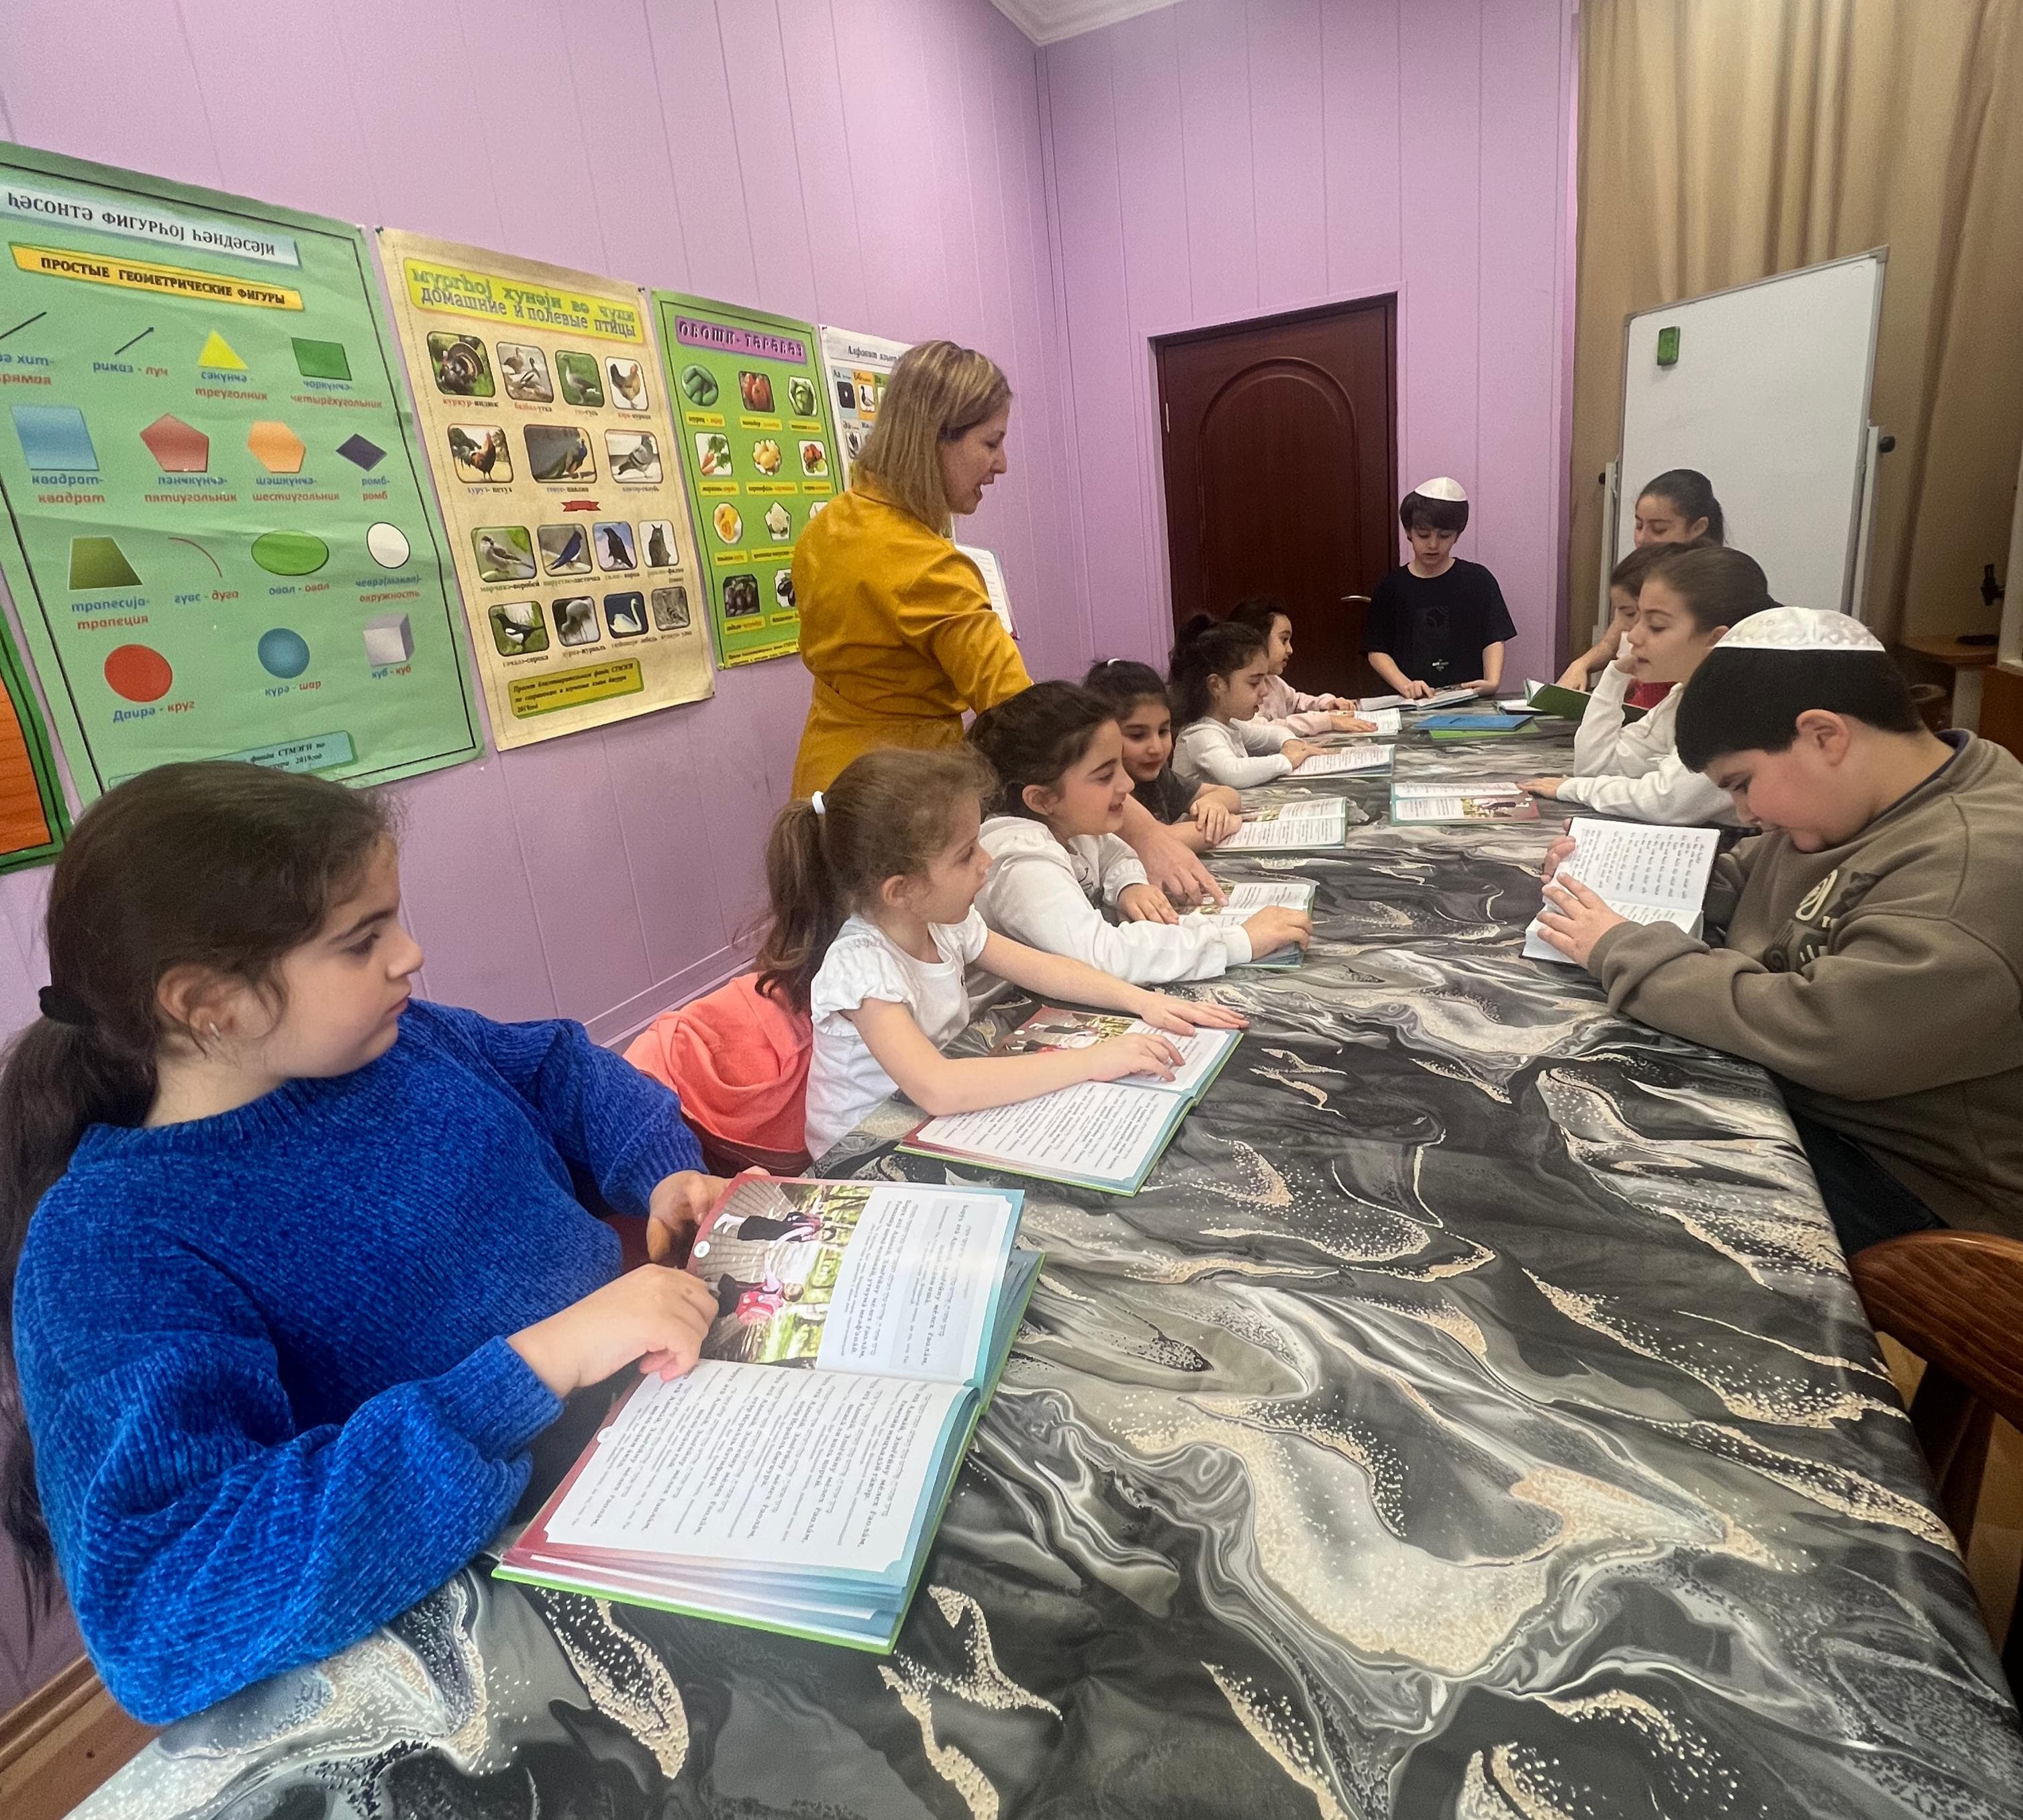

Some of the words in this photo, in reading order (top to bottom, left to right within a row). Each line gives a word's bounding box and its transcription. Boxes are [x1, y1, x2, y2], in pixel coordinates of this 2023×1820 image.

[41, 257, 110, 278] ПРОСТЫЕ
[119, 269, 232, 297] ГЕОМЕТРИЧЕСКИЕ
[238, 289, 285, 305] ФИГУРЫ
[513, 303, 524, 319] и
[526, 306, 588, 330] полевые
[594, 319, 637, 339] птицы
[0, 373, 52, 387] рямая
[38, 491, 105, 505] квадрат
[144, 493, 238, 505] пятиугольник
[252, 492, 340, 503] шестиугольник
[362, 491, 388, 502] ромб
[305, 583, 330, 593] овал
[359, 590, 420, 603] окружность
[77, 614, 149, 631] трапеция
[395, 665, 411, 676] куб
[299, 680, 322, 692] шар
[167, 701, 195, 714] круг
[278, 742, 313, 757] СТМЭГИ
